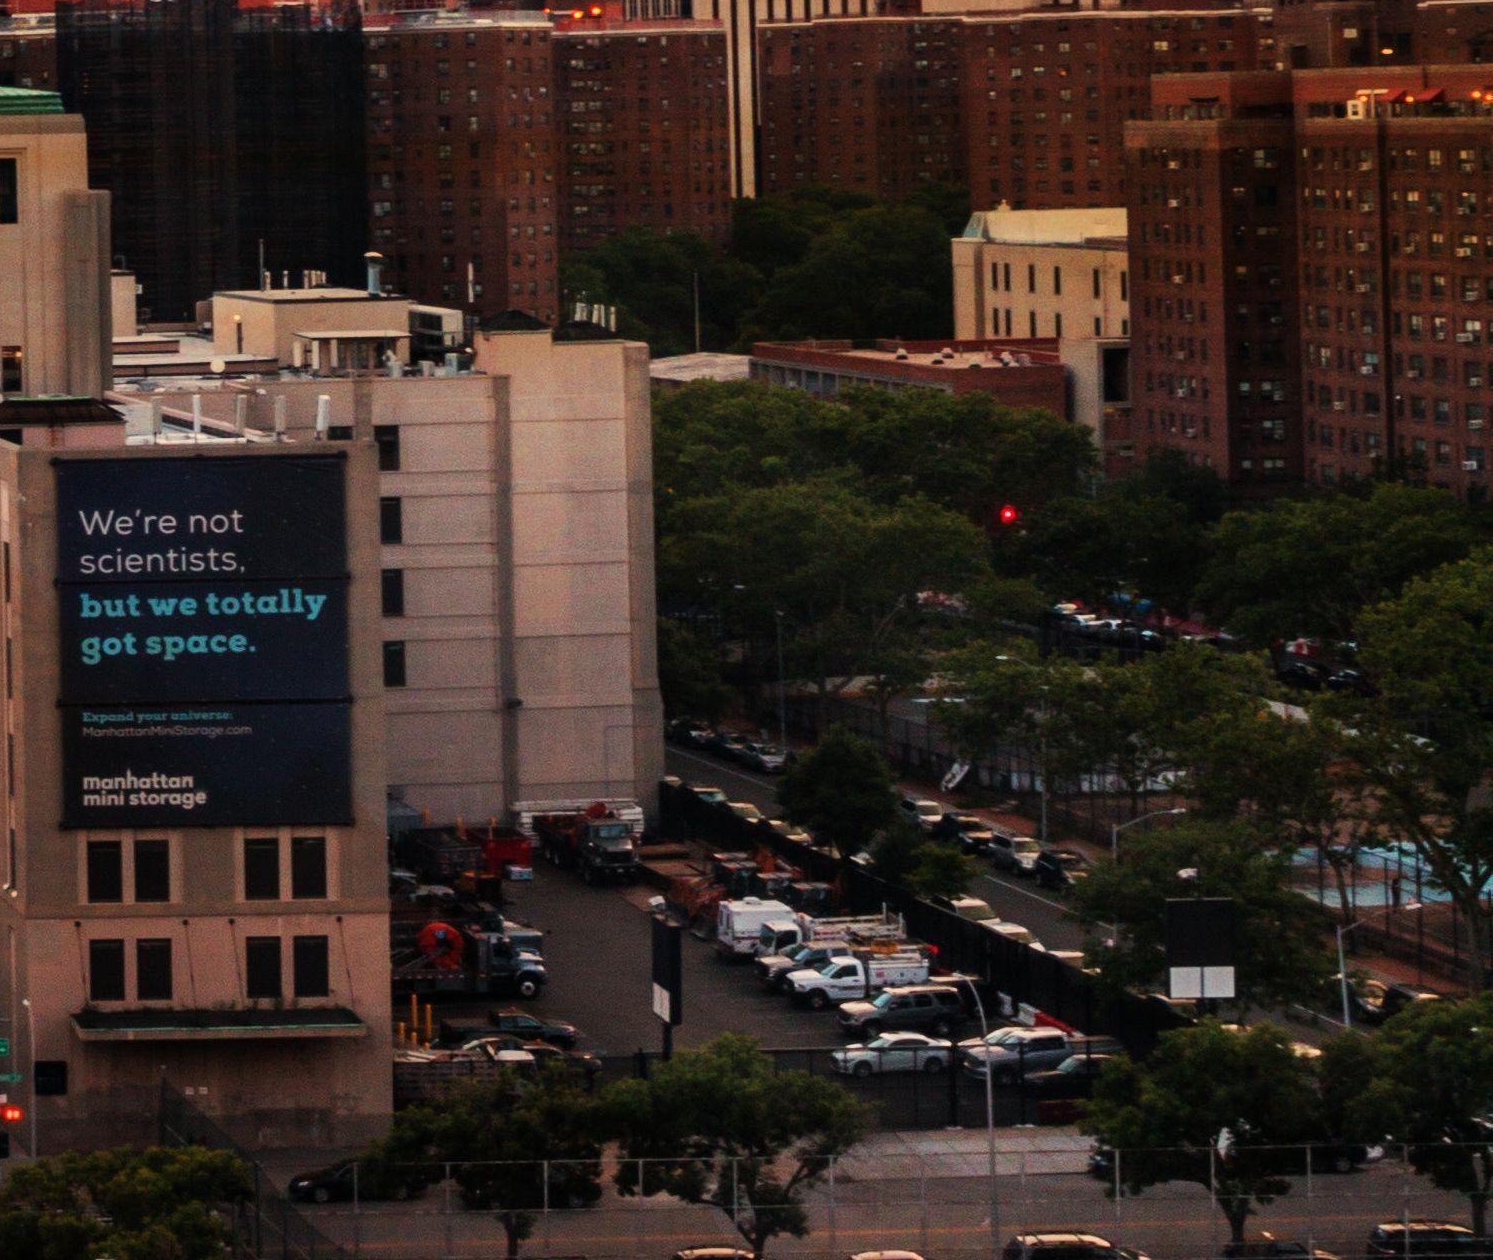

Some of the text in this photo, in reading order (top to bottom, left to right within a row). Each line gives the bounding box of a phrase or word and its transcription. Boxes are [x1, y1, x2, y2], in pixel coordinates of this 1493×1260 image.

[78, 509, 244, 535] We're not
[79, 547, 245, 574] scientists,
[80, 588, 327, 621] but we totally
[80, 632, 257, 665] got space.
[82, 711, 134, 725] Expand
[137, 712, 168, 724] your
[82, 725, 252, 739] ManhattanMiniStorage.com
[83, 767, 194, 789] manhattan
[83, 790, 207, 809] mini storage
